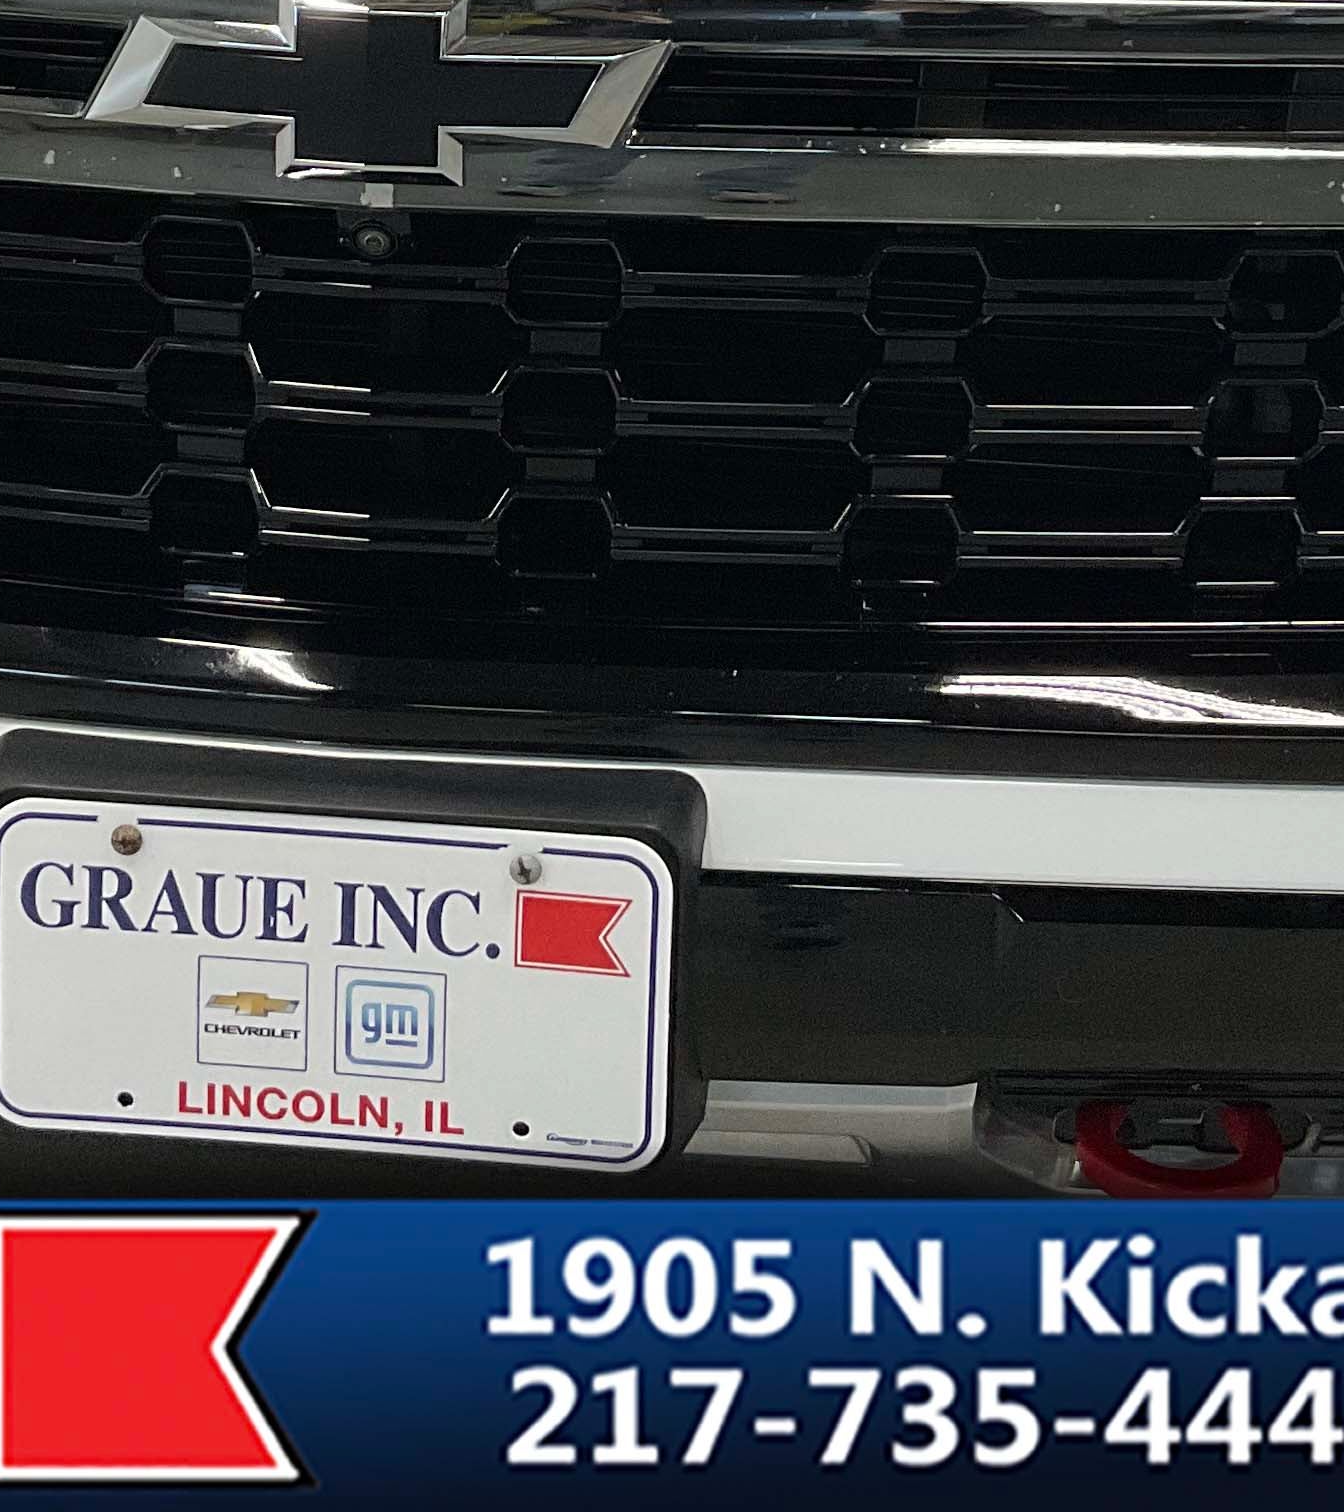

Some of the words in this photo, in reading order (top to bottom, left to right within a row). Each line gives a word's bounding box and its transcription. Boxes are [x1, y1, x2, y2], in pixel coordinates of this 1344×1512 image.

[19, 862, 310, 944] GRAUE
[333, 881, 501, 960] INC.
[204, 1023, 301, 1040] CHEVROLET
[361, 1002, 418, 1047] gm
[178, 1081, 404, 1137] LINCOLN,
[424, 1100, 465, 1136] IL
